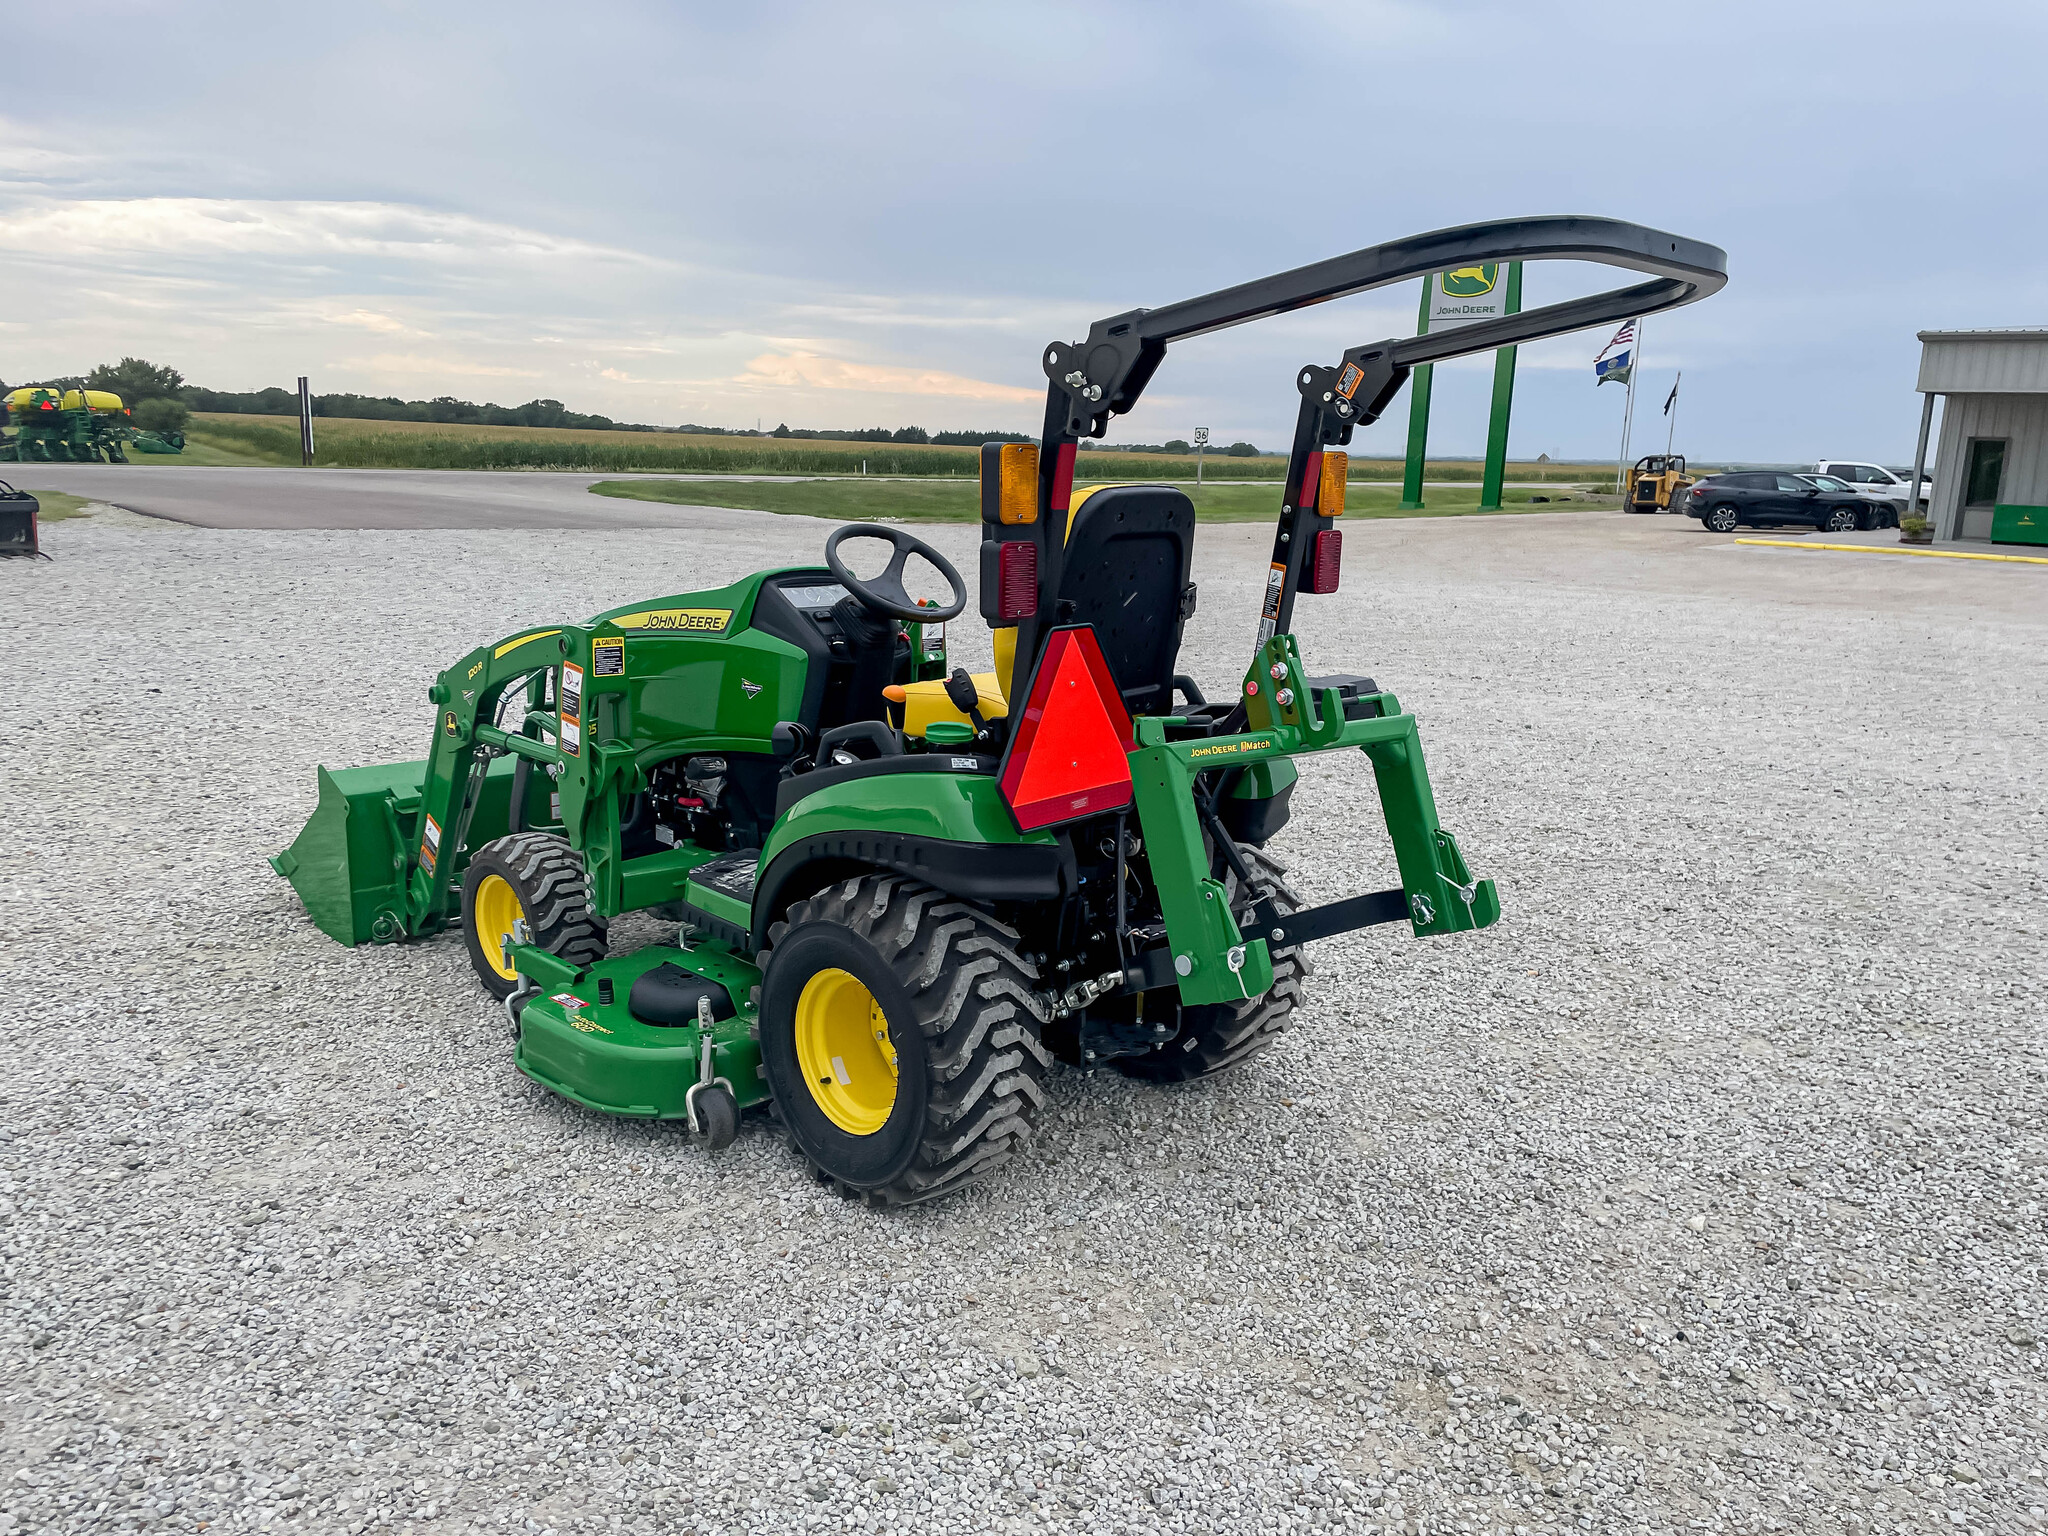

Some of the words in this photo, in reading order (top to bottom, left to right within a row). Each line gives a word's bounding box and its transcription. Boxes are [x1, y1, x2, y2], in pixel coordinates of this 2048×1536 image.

[1437, 306, 1461, 315] JOHN
[1462, 305, 1496, 314] DEERE
[1196, 430, 1207, 440] 36
[642, 613, 677, 628] JOHN
[679, 613, 722, 629] DEERE
[601, 638, 623, 646] CAUTION
[1190, 748, 1212, 758] JOHN
[1211, 744, 1238, 755] DEERE
